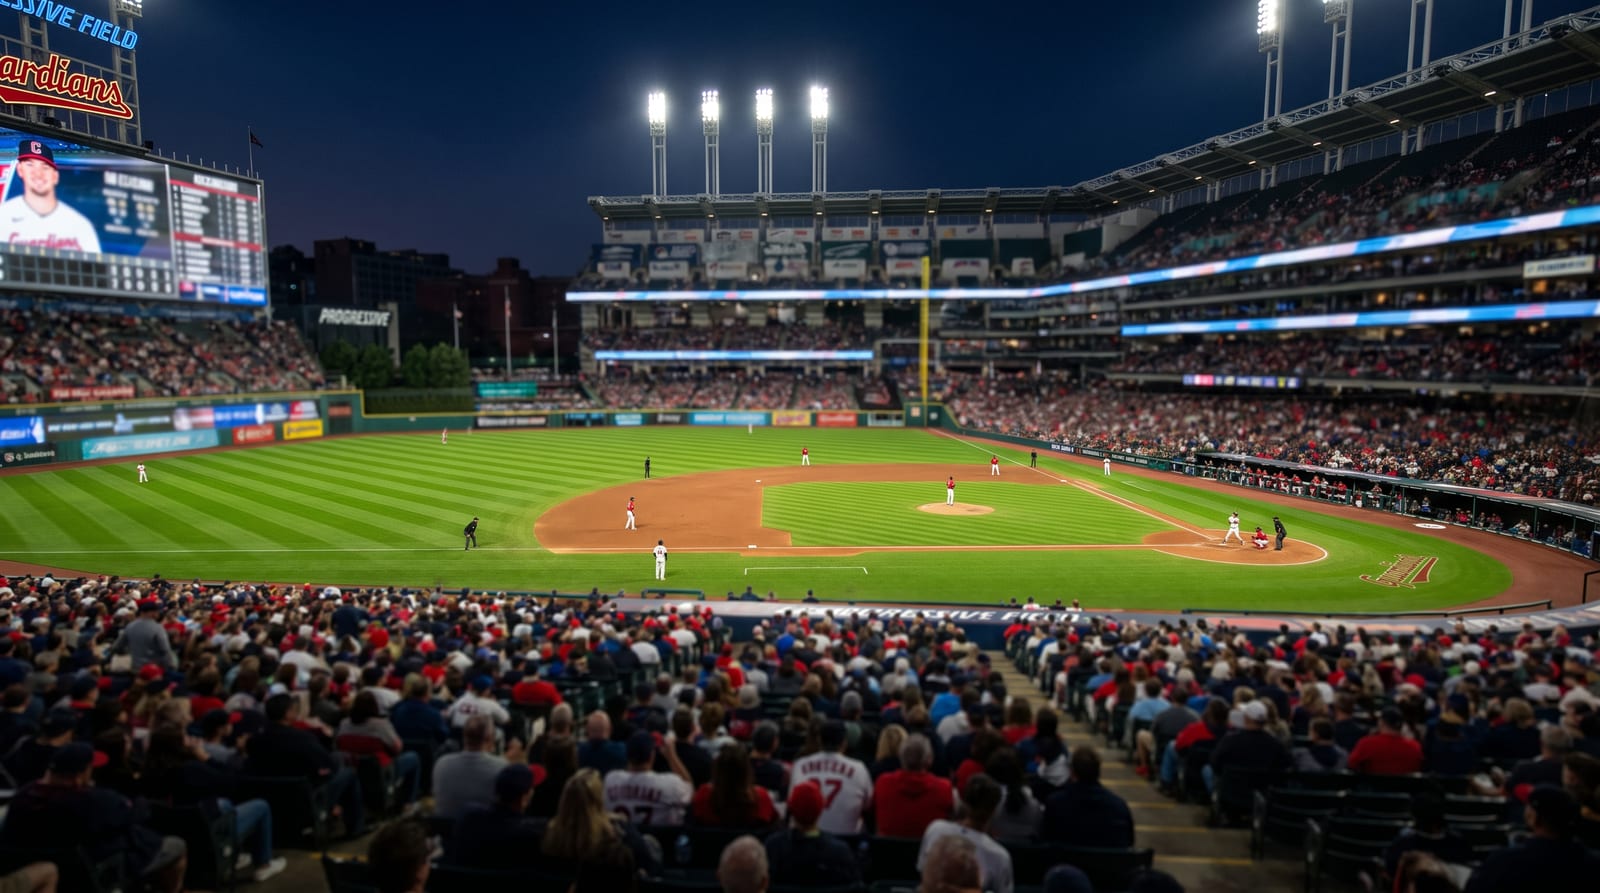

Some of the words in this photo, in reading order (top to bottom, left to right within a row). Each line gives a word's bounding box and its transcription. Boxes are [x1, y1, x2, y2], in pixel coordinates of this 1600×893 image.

[78, 14, 138, 50] FIELD
[0, 53, 124, 107] ardians
[30, 141, 42, 155] C
[319, 307, 391, 327] PROGRESSIVE
